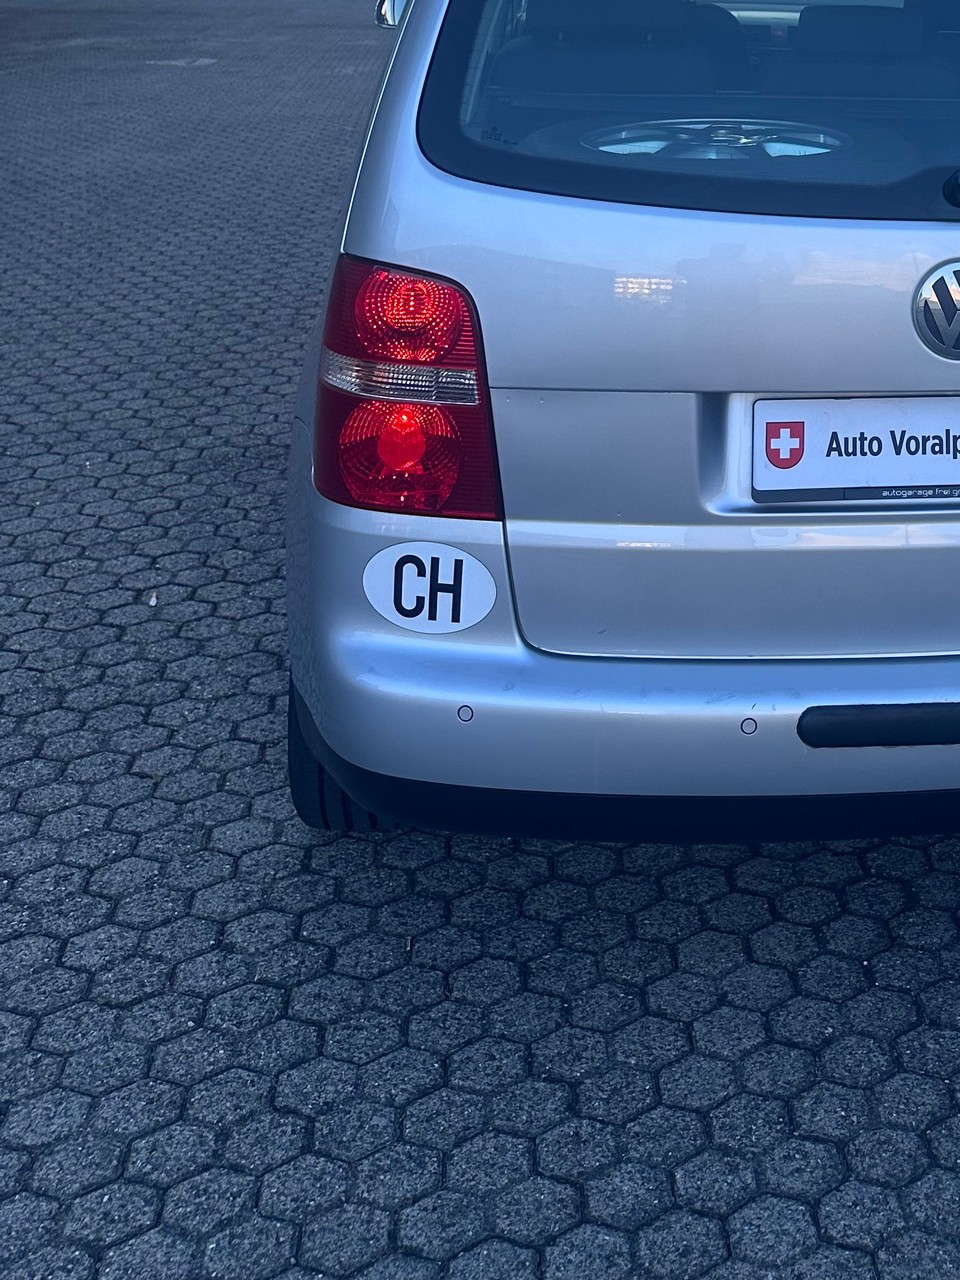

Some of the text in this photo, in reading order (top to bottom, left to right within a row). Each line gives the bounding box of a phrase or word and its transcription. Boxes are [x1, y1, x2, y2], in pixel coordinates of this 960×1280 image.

[825, 431, 883, 457] Auto
[882, 488, 934, 498] autogarage
[935, 487, 951, 496] frei
[393, 554, 464, 624] CH
